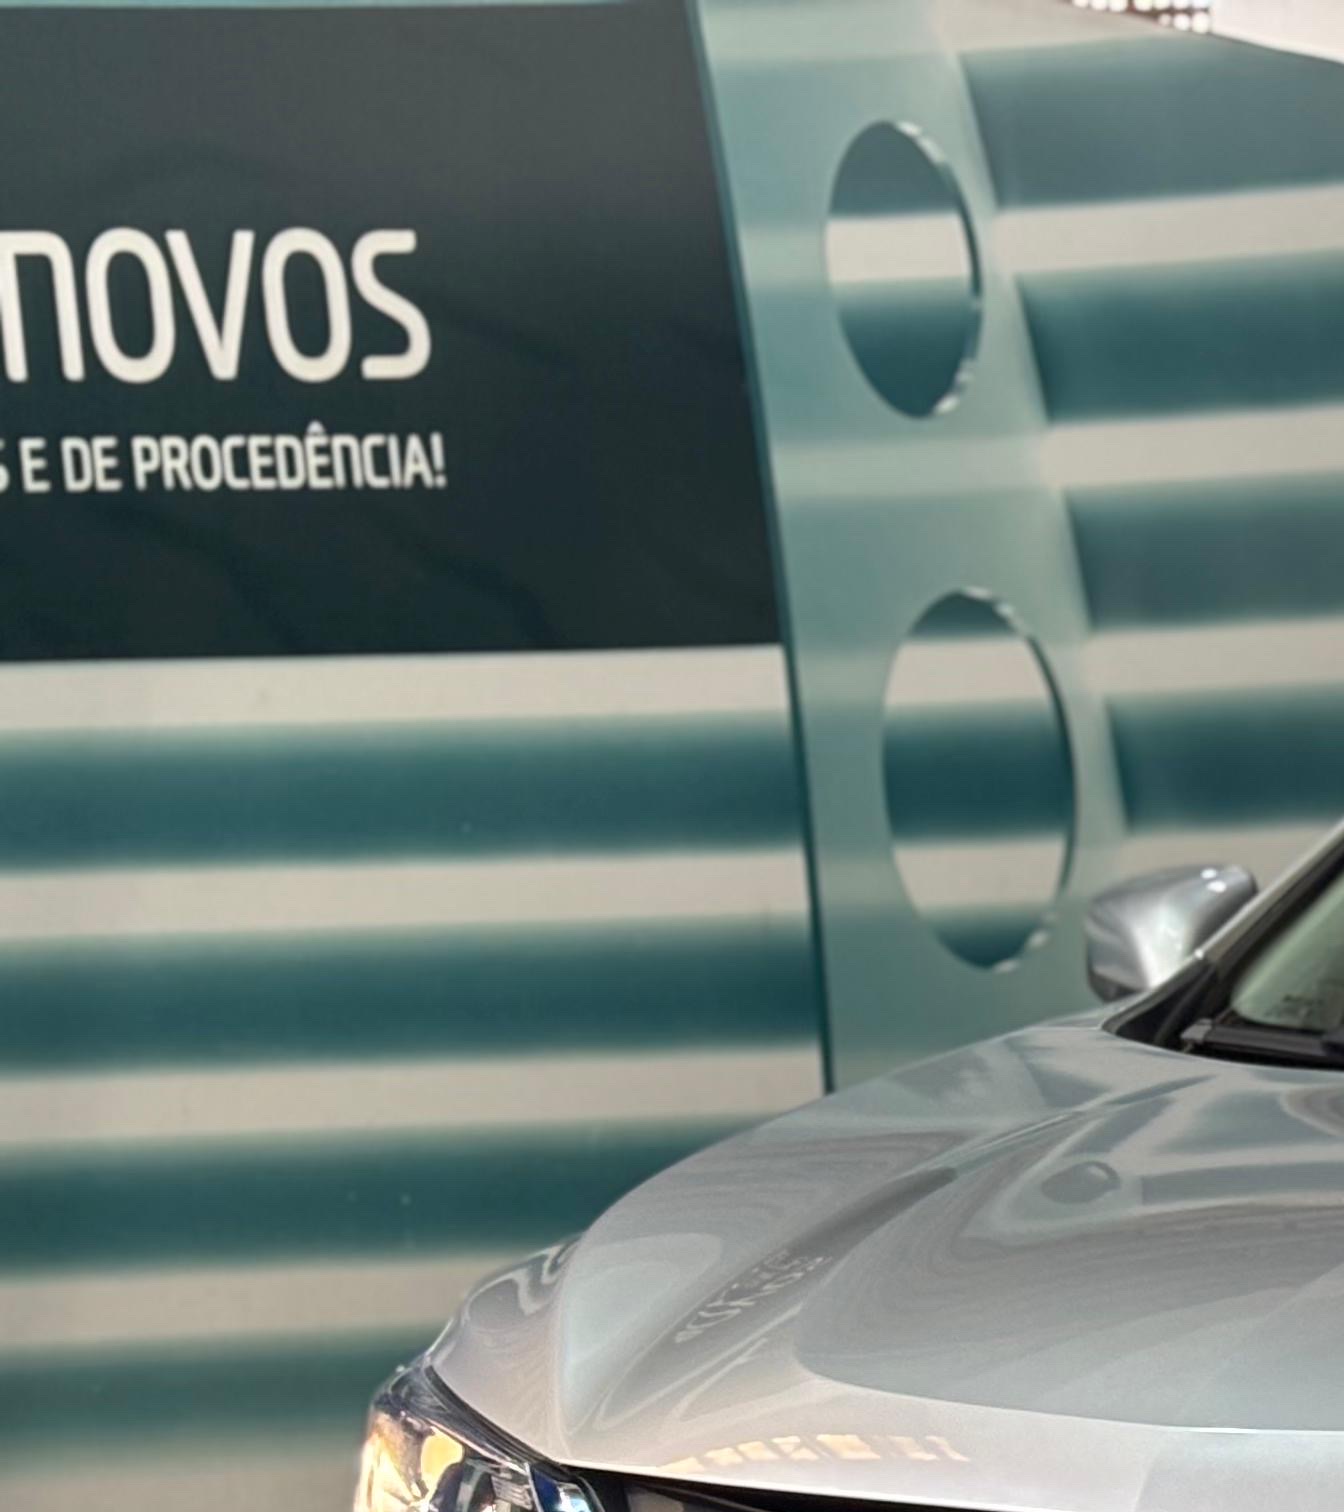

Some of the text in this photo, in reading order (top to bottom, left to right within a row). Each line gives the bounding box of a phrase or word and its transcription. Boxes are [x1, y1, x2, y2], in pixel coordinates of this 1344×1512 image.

[19, 437, 51, 492] E
[61, 436, 122, 492] DE
[132, 420, 447, 491] PROCEDÊNCIA!
